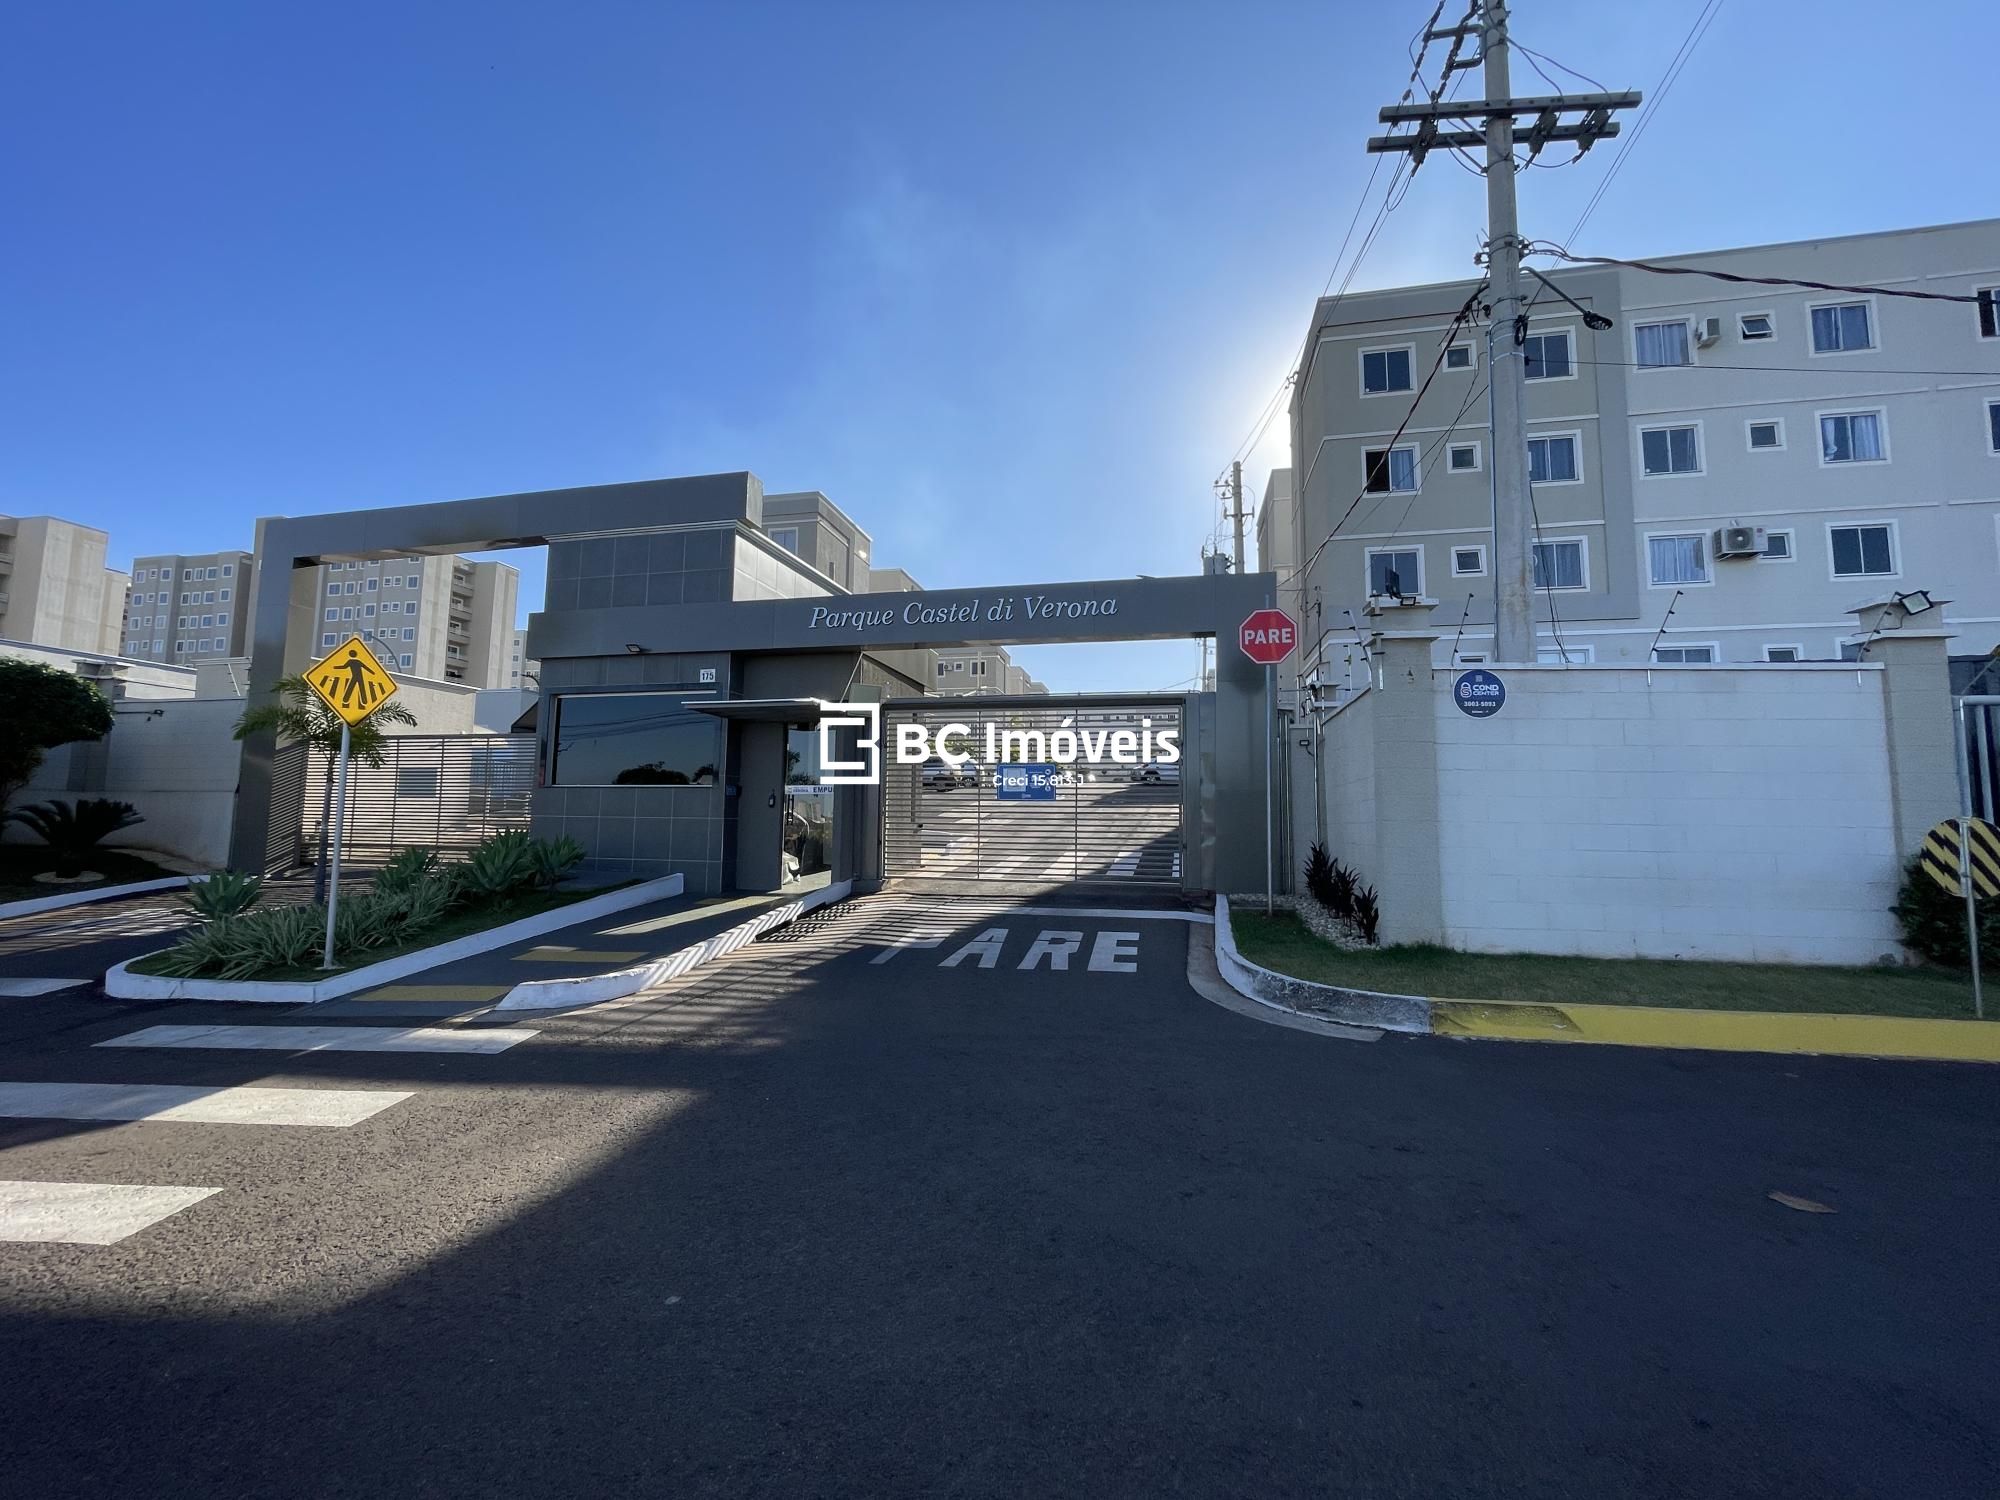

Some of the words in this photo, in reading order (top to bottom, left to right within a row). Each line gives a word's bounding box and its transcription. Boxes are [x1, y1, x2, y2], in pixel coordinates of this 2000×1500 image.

[809, 606, 894, 631] Parque
[903, 599, 979, 625] Castel
[987, 598, 1014, 622] di
[1024, 596, 1118, 620] Verona
[1244, 627, 1292, 645] PARE
[702, 672, 714, 680] 175
[868, 928, 1140, 972] PARE
